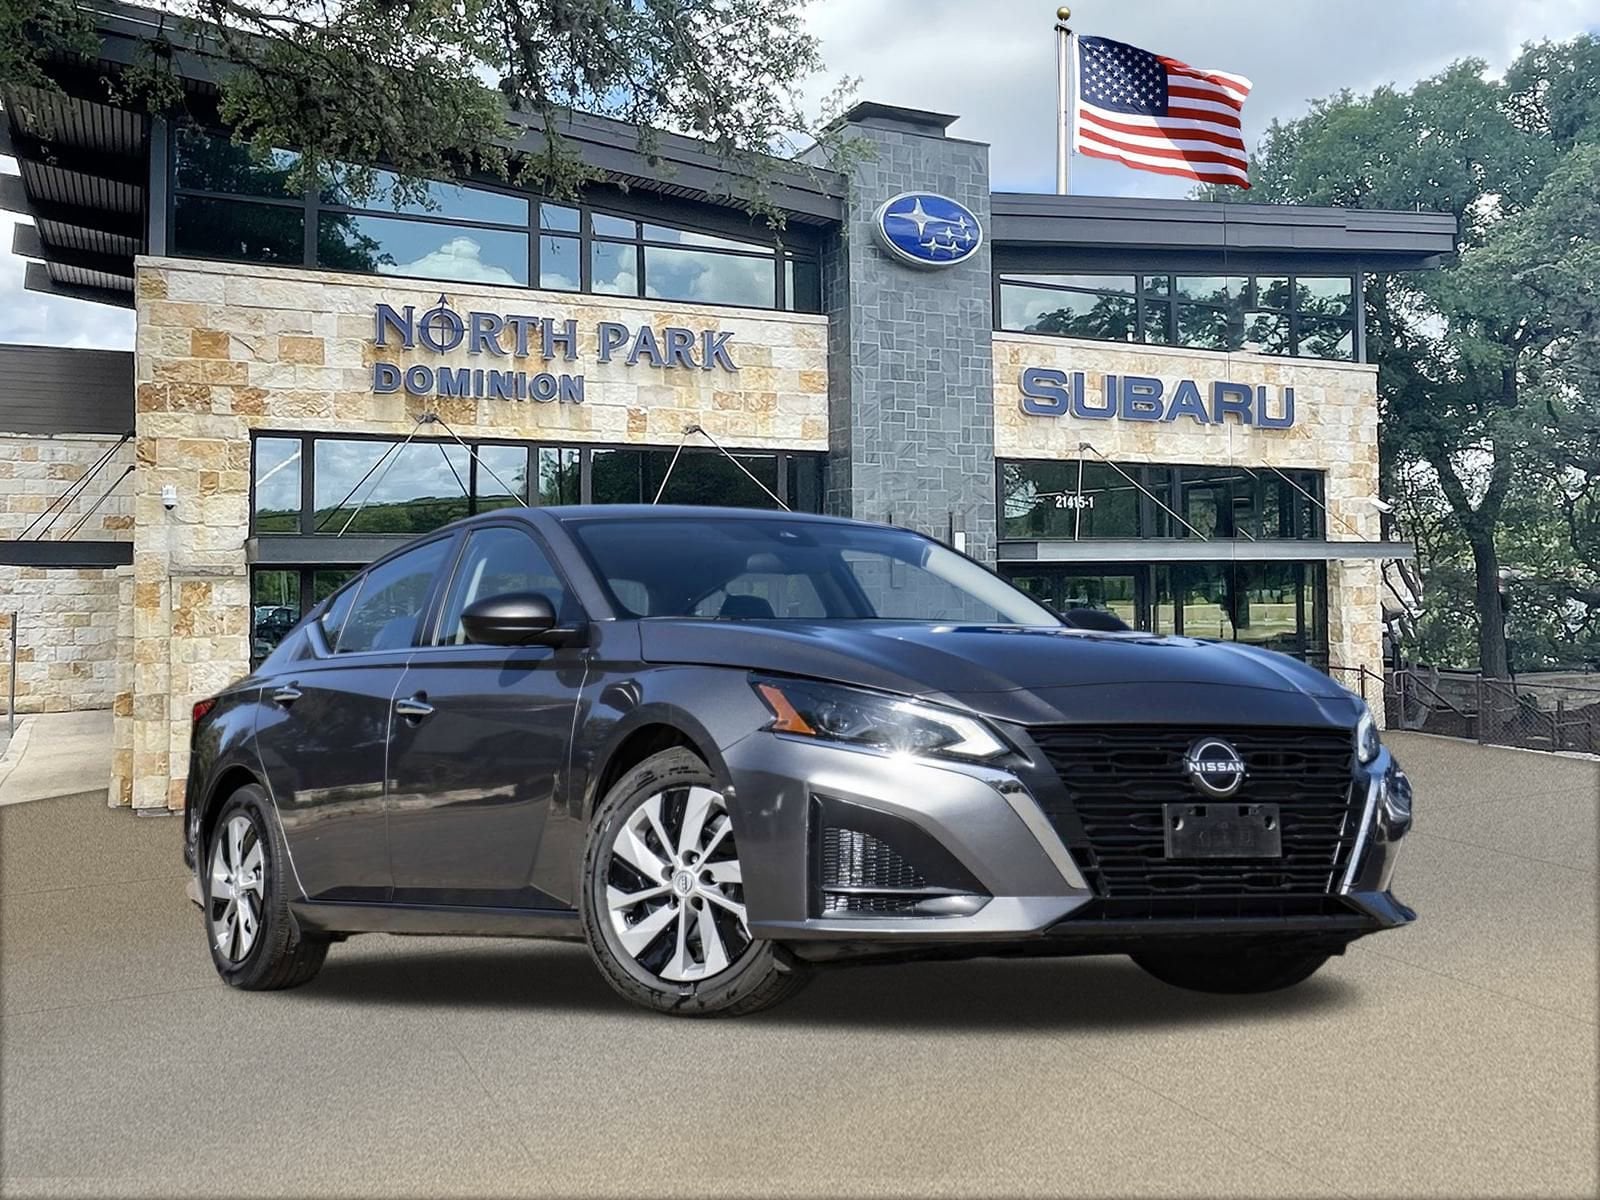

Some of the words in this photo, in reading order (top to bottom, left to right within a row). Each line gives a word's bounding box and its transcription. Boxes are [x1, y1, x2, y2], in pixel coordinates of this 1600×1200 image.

[374, 296, 579, 361] NORTH
[597, 320, 741, 372] PARK
[373, 361, 585, 404] DOMINION
[1019, 367, 1295, 429] SUBARU
[1188, 762, 1245, 772] NISSAN
